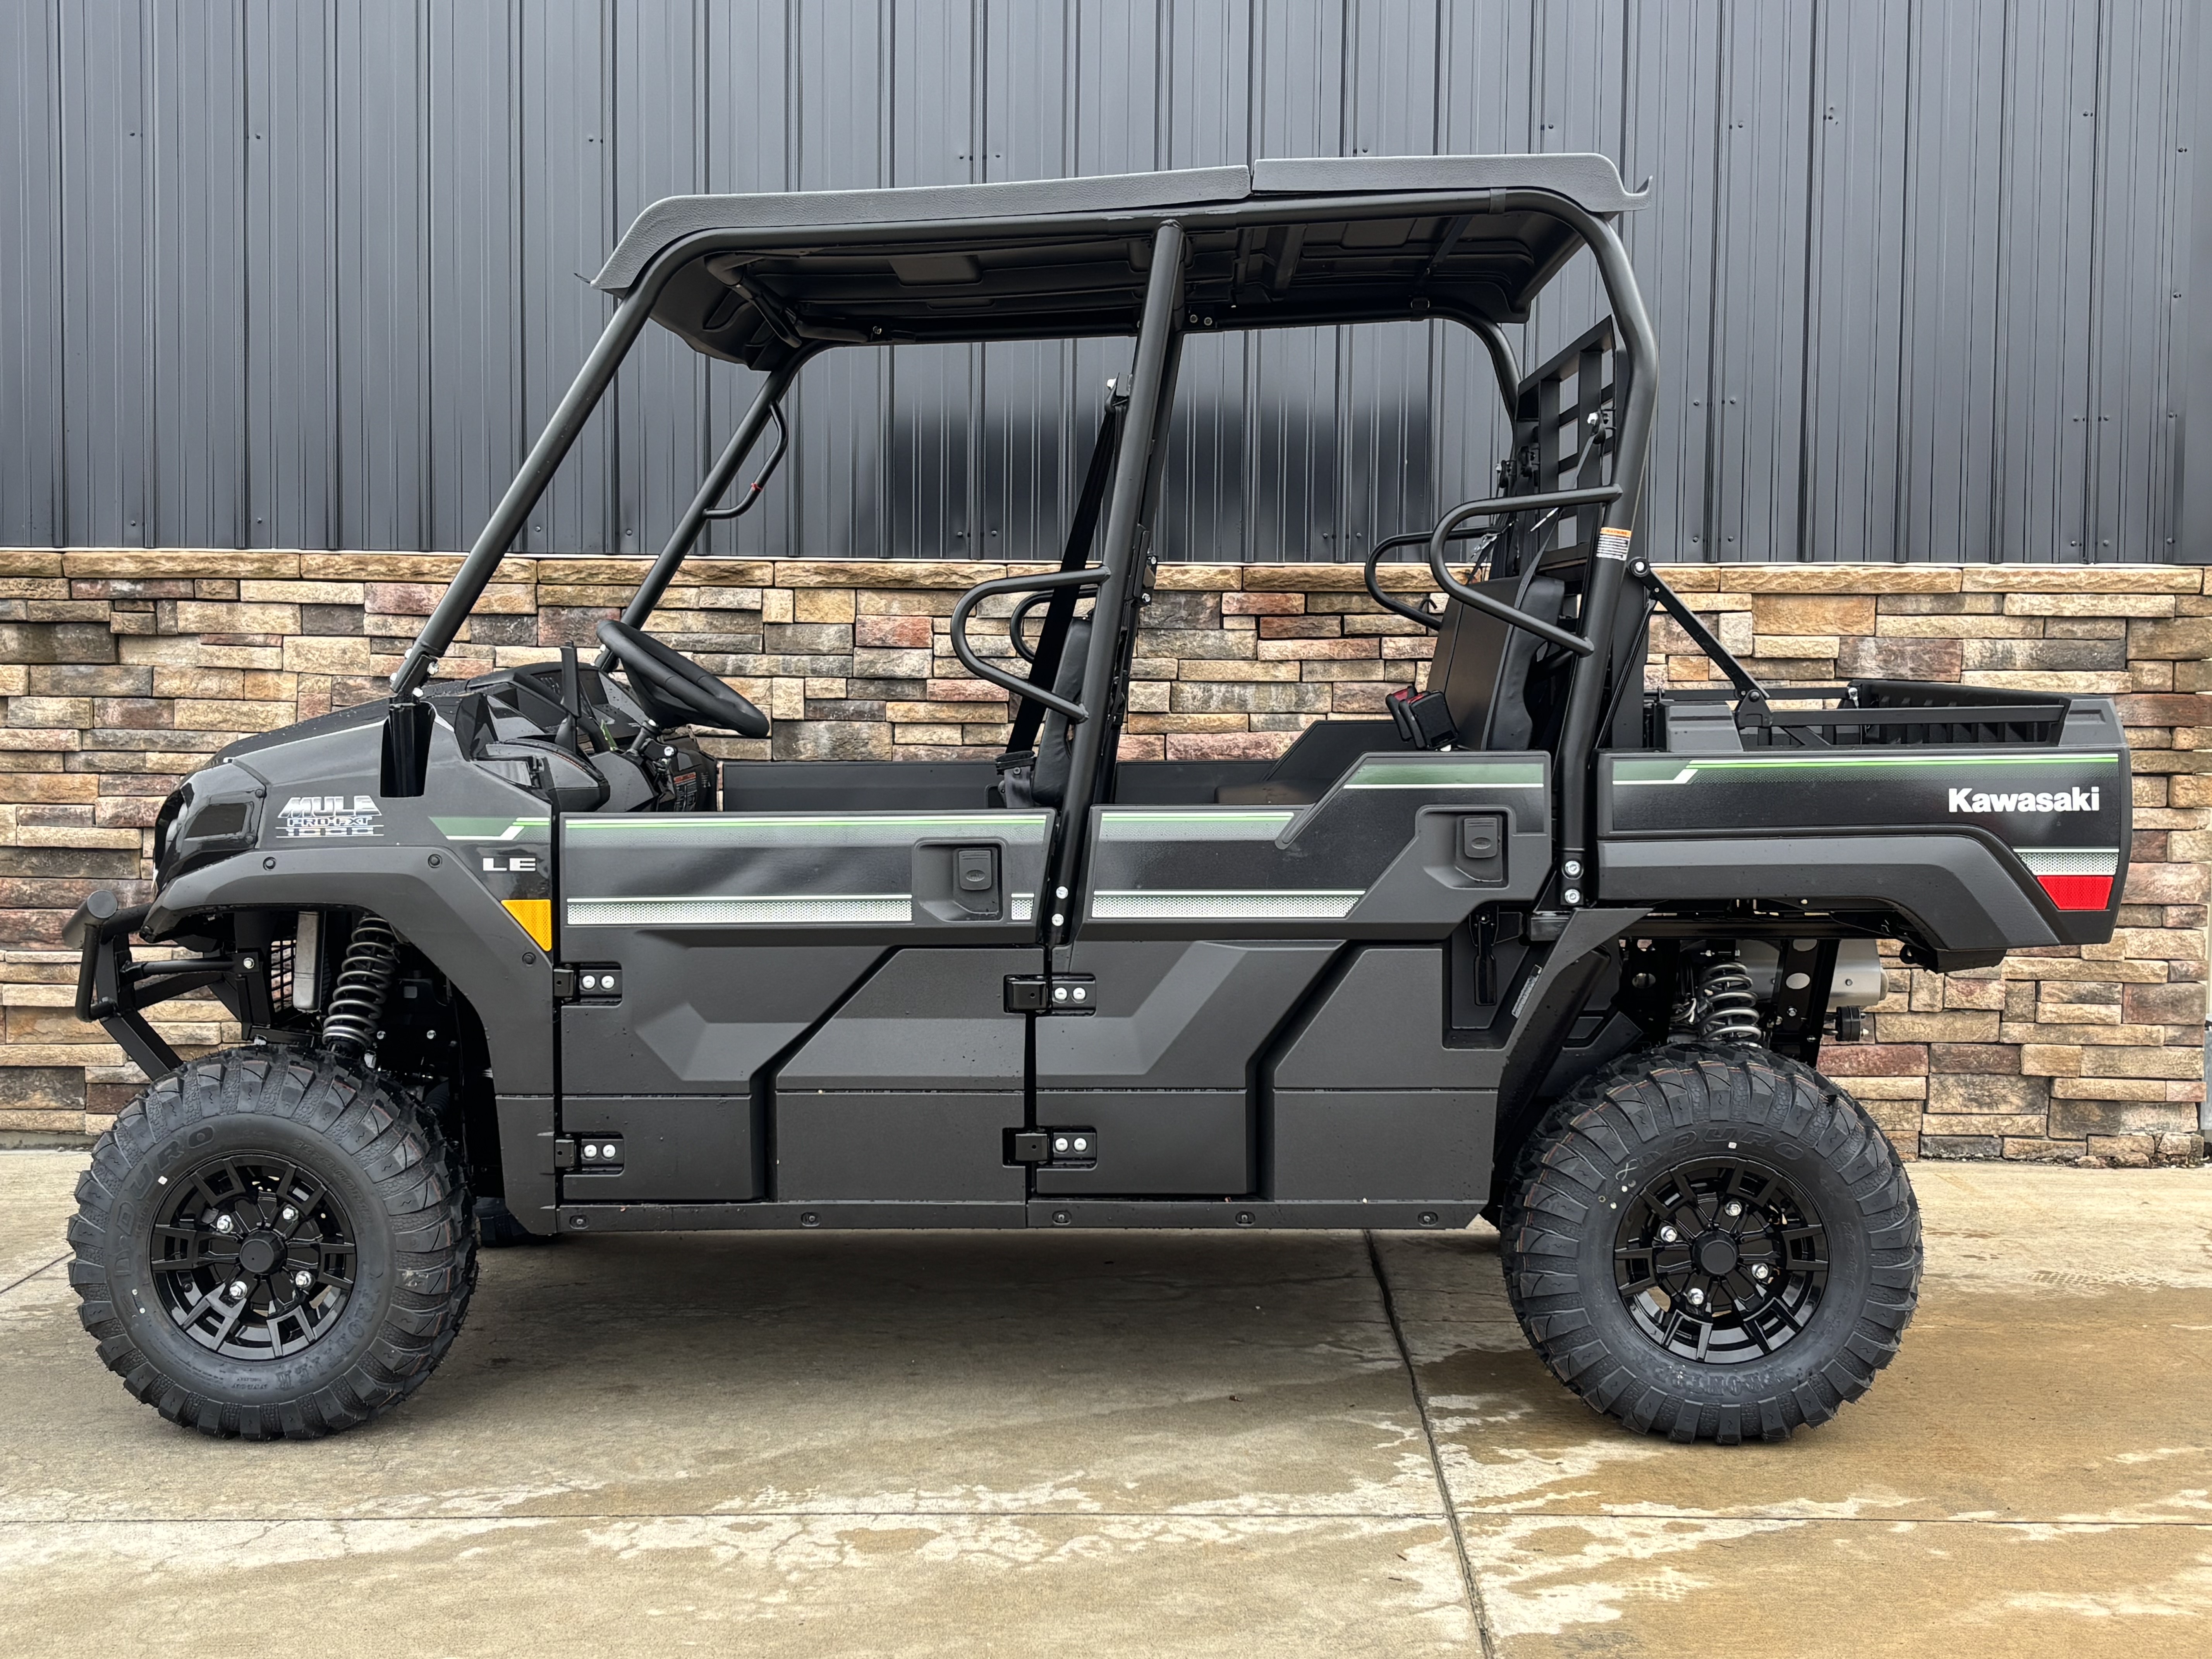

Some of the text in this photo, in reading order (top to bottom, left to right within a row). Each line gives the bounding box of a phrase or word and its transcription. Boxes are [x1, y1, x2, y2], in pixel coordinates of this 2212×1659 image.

[278, 795, 382, 818] MULE
[1949, 787, 2099, 812] Kawasaki
[286, 828, 373, 836] 1000
[483, 858, 536, 871] LE
[1672, 1127, 1803, 1160] DURO
[117, 1125, 215, 1235] DURO
